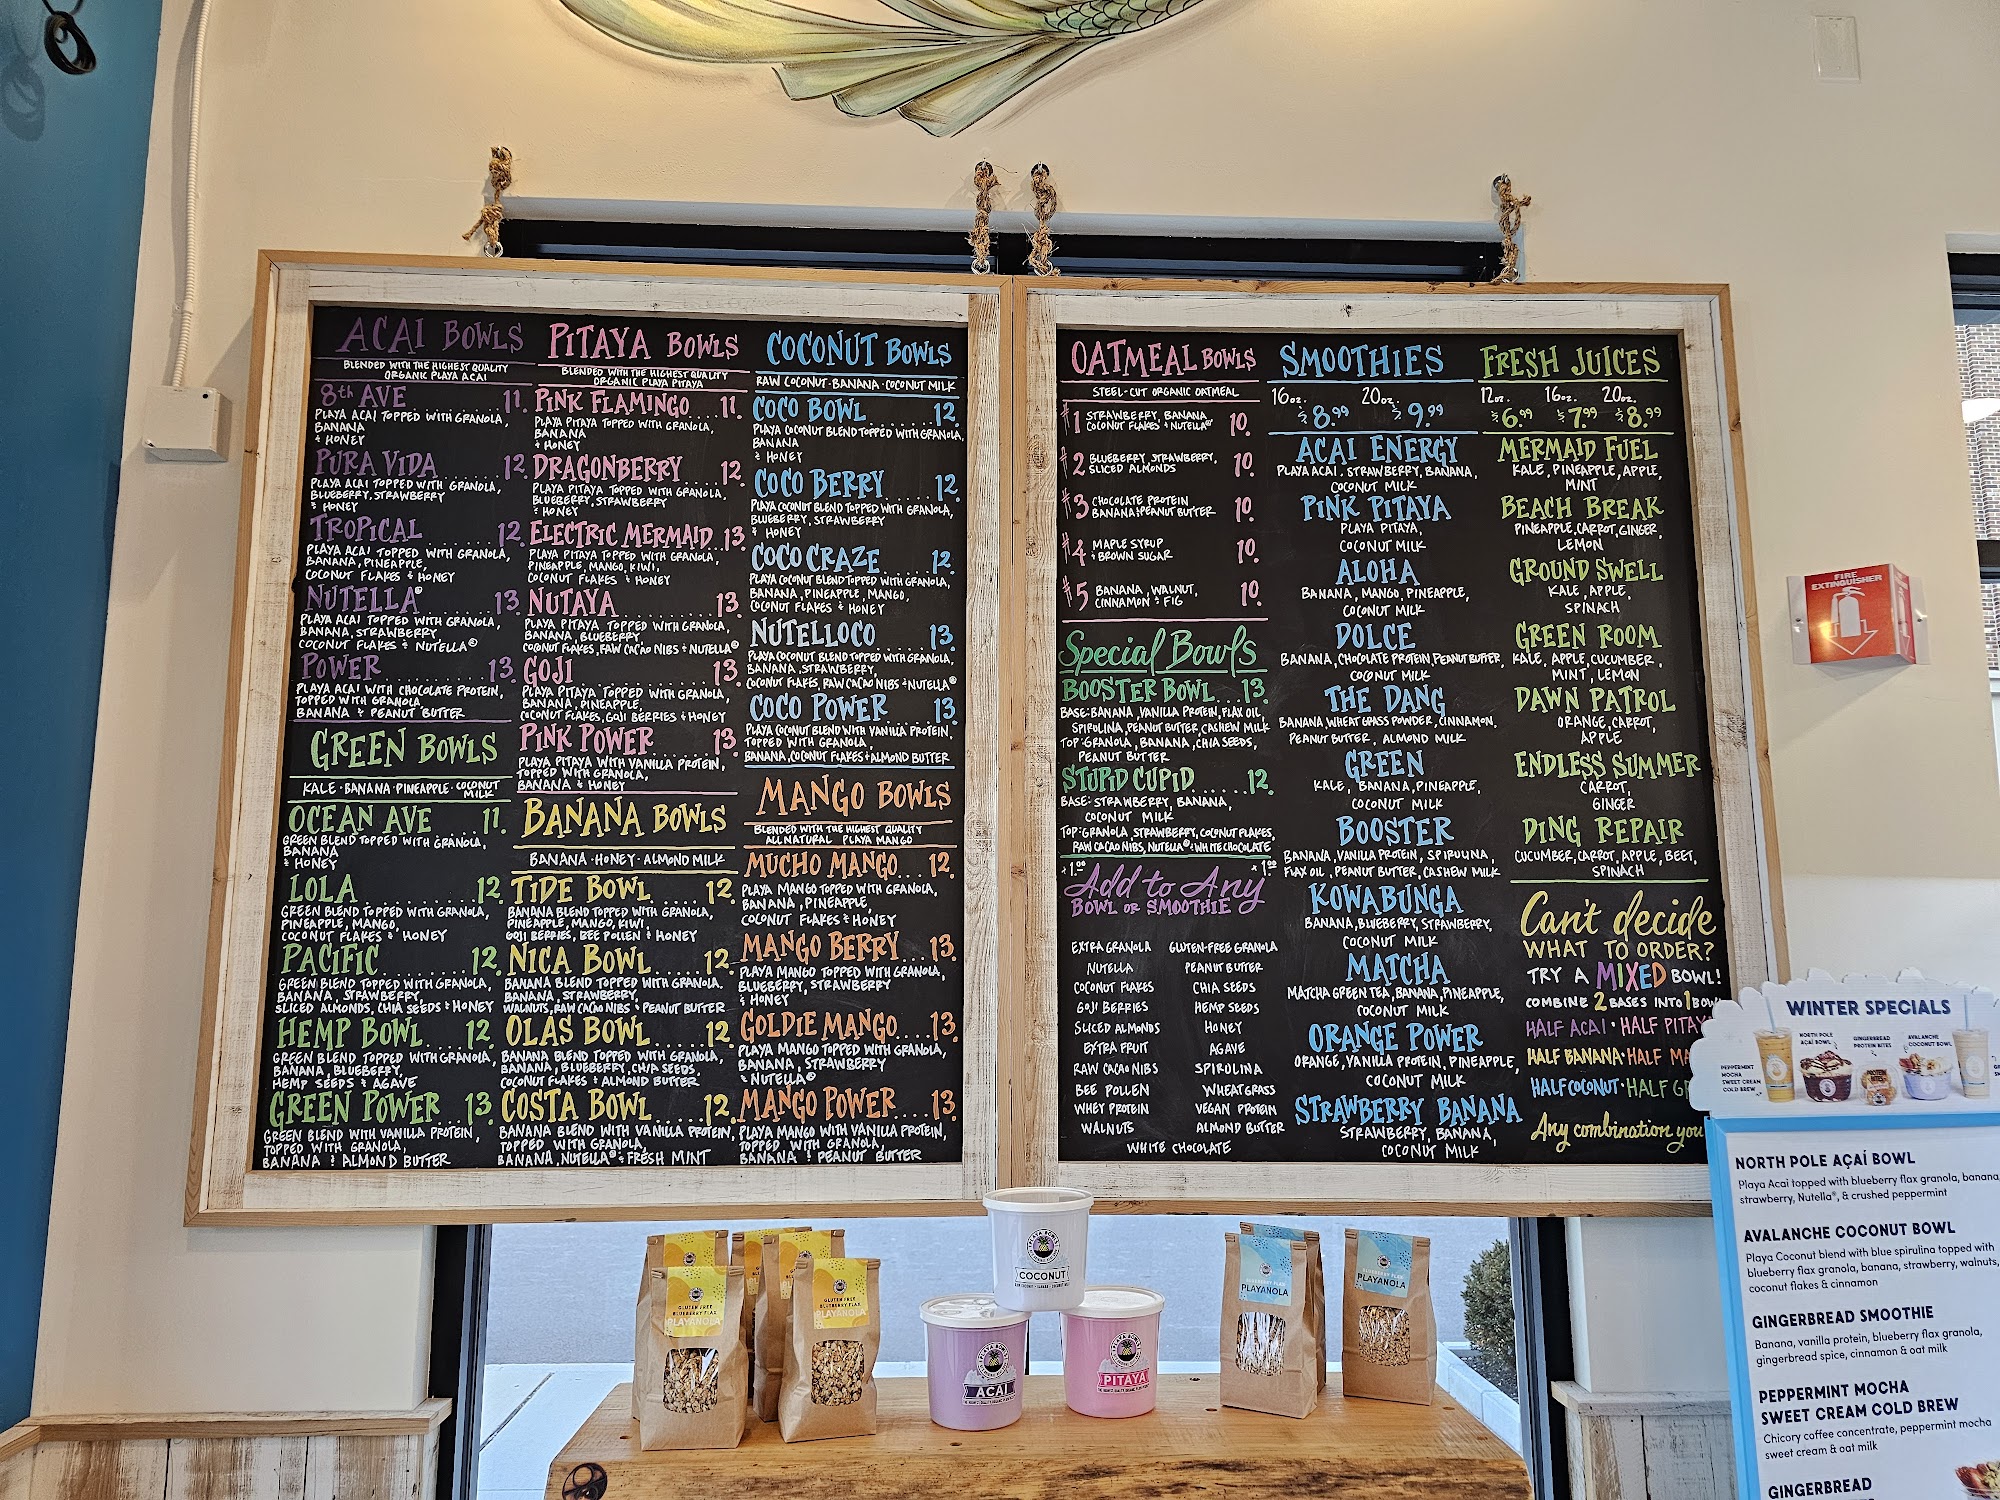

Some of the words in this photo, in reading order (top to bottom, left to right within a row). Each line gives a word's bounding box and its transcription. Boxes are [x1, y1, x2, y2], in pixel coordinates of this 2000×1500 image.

[337, 318, 425, 354] ACAI
[443, 320, 523, 353] BOWLS
[667, 332, 739, 360] BOWLS
[767, 330, 878, 366] COCONUT
[885, 338, 952, 367] BOWLS
[344, 360, 385, 369] BLENDED
[389, 361, 410, 369] WITH
[413, 361, 429, 370] THE
[430, 362, 470, 371] HIGHEST
[472, 363, 508, 373] QUALITY
[1072, 339, 1197, 377] OATMEAL
[1201, 348, 1256, 371] BOWLS
[1280, 341, 1443, 378] SMOOTHIES
[1480, 345, 1559, 379] FRESH
[1571, 346, 1660, 376] JUICES
[358, 384, 406, 407] AVE
[1152, 387, 1190, 396] ORGANIC
[1195, 386, 1239, 397] OATMEAL
[1295, 437, 1357, 465] ACAI
[1370, 435, 1458, 466] ENERGY
[1604, 436, 1658, 461] FUEL
[315, 449, 377, 476] PURA
[533, 454, 683, 483] DRAGONBERRY
[755, 467, 803, 498] COCO
[809, 469, 884, 500] BERRY
[1501, 495, 1572, 520] BEACH
[1583, 496, 1664, 521] BREAK
[1093, 538, 1127, 551] MAPLE
[1129, 537, 1164, 551] SYRUP
[1558, 538, 1604, 551] LEMON
[752, 542, 802, 571] COCO
[806, 543, 880, 573] CRAZE
[1335, 558, 1420, 586] ALOHA
[1811, 575, 1883, 590] EXTINGUISHER
[1834, 572, 1858, 580] FIRE
[528, 587, 619, 617] NUTAYA
[1059, 628, 1166, 674] Special
[1169, 625, 1258, 672] Bowls
[1516, 621, 1586, 654] GREEN
[1597, 624, 1662, 649] ROOM
[311, 727, 406, 771] GREEN
[417, 732, 497, 764] BOWLS
[1514, 750, 1606, 780] ENDLESS
[1612, 751, 1701, 779] SUMMER
[756, 774, 864, 817] MANGO
[877, 780, 951, 810] BOWLS
[289, 805, 373, 836] OCEAN
[382, 805, 431, 835] AVE
[521, 796, 645, 838] BANANA
[653, 803, 726, 833] BOWLS
[1085, 811, 1132, 823] COCONUT
[1142, 811, 1174, 823] MILK
[744, 851, 821, 878] MUCHO
[827, 851, 897, 881] MANGO
[288, 874, 358, 903] LOLA
[587, 875, 653, 903] BOWL
[1308, 883, 1464, 918] KOWABUNGA
[1071, 898, 1118, 917] BOWL
[1147, 897, 1231, 916] SMOOTHIE
[1523, 939, 1588, 958] WHAT
[1603, 940, 1628, 960] TO
[1637, 941, 1714, 961] ORDER?
[1087, 962, 1133, 975] NUTELLA
[1185, 962, 1224, 973] PEANUT
[1226, 962, 1263, 973] BUTTER
[1346, 952, 1451, 986] MATCHA
[1527, 967, 1562, 984] TRY
[1575, 967, 1589, 984] A
[1596, 962, 1666, 992] MIXED
[1671, 969, 1721, 984] BOWL!
[1786, 1000, 1860, 1016] WINTER
[1866, 1000, 1951, 1015] SPECIALS
[277, 1017, 351, 1051] HEMP
[361, 1017, 423, 1049] BOWL
[1205, 1020, 1242, 1034] HONEY
[1210, 1042, 1245, 1056] AGAVE
[1076, 1083, 1097, 1097] BEE
[1105, 1083, 1149, 1097] POLLEN
[270, 1090, 352, 1131] GREEN
[362, 1090, 441, 1125] POWER
[502, 1088, 579, 1123] COSTA
[588, 1088, 652, 1121] BOWL
[1295, 1094, 1424, 1125] STRAWBERRY
[1437, 1093, 1523, 1127] BANANA
[264, 1129, 302, 1144] GREEN
[308, 1129, 343, 1142] BLEND
[349, 1128, 376, 1140] WITH
[380, 1127, 425, 1139] VANILLA
[1081, 1121, 1134, 1135] WALNUTS
[1127, 1141, 1166, 1153] WHITE
[1172, 1140, 1231, 1155] CHOCOLATE
[1736, 1156, 1786, 1170] NORTH
[1790, 1154, 1827, 1168] POLE
[1872, 1152, 1916, 1165] BOWL
[1744, 1226, 1830, 1243] AVALANCHE
[1835, 1223, 1908, 1238] COCONUT
[1912, 1222, 1956, 1234] BOWL
[1019, 1271, 1066, 1280] COCONUT
[1358, 1273, 1406, 1289] PLAYANOLA
[1242, 1284, 1288, 1297] PLAYANOLA
[668, 1318, 721, 1327] PLAYANOLA
[816, 1309, 866, 1318] PLAYANOLA
[1752, 1310, 1854, 1329] GINGERBREAD
[1860, 1306, 1934, 1322] SMOOTHIE
[1756, 1352, 1818, 1368] gingerbread
[1820, 1350, 1848, 1362] spice,
[1850, 1347, 1898, 1359] cinnamon
[1900, 1346, 1907, 1355] &
[1909, 1344, 1926, 1354] oat
[1928, 1344, 1948, 1354] milk
[975, 1384, 1009, 1398] ACAI
[1104, 1372, 1146, 1387] PITAYA
[1758, 1384, 1850, 1404] PEPPERMINT
[1854, 1380, 1910, 1396] MOCHA
[1762, 1408, 1810, 1426] SWEET
[1815, 1404, 1867, 1421] CREAM
[1872, 1400, 1912, 1416] COLD
[1918, 1398, 1959, 1413] BREW
[1766, 1450, 1794, 1460] sweet
[1796, 1446, 1828, 1458] cream
[1830, 1445, 1837, 1454] &
[1839, 1444, 1856, 1454] oat
[1858, 1441, 1878, 1452] milk
